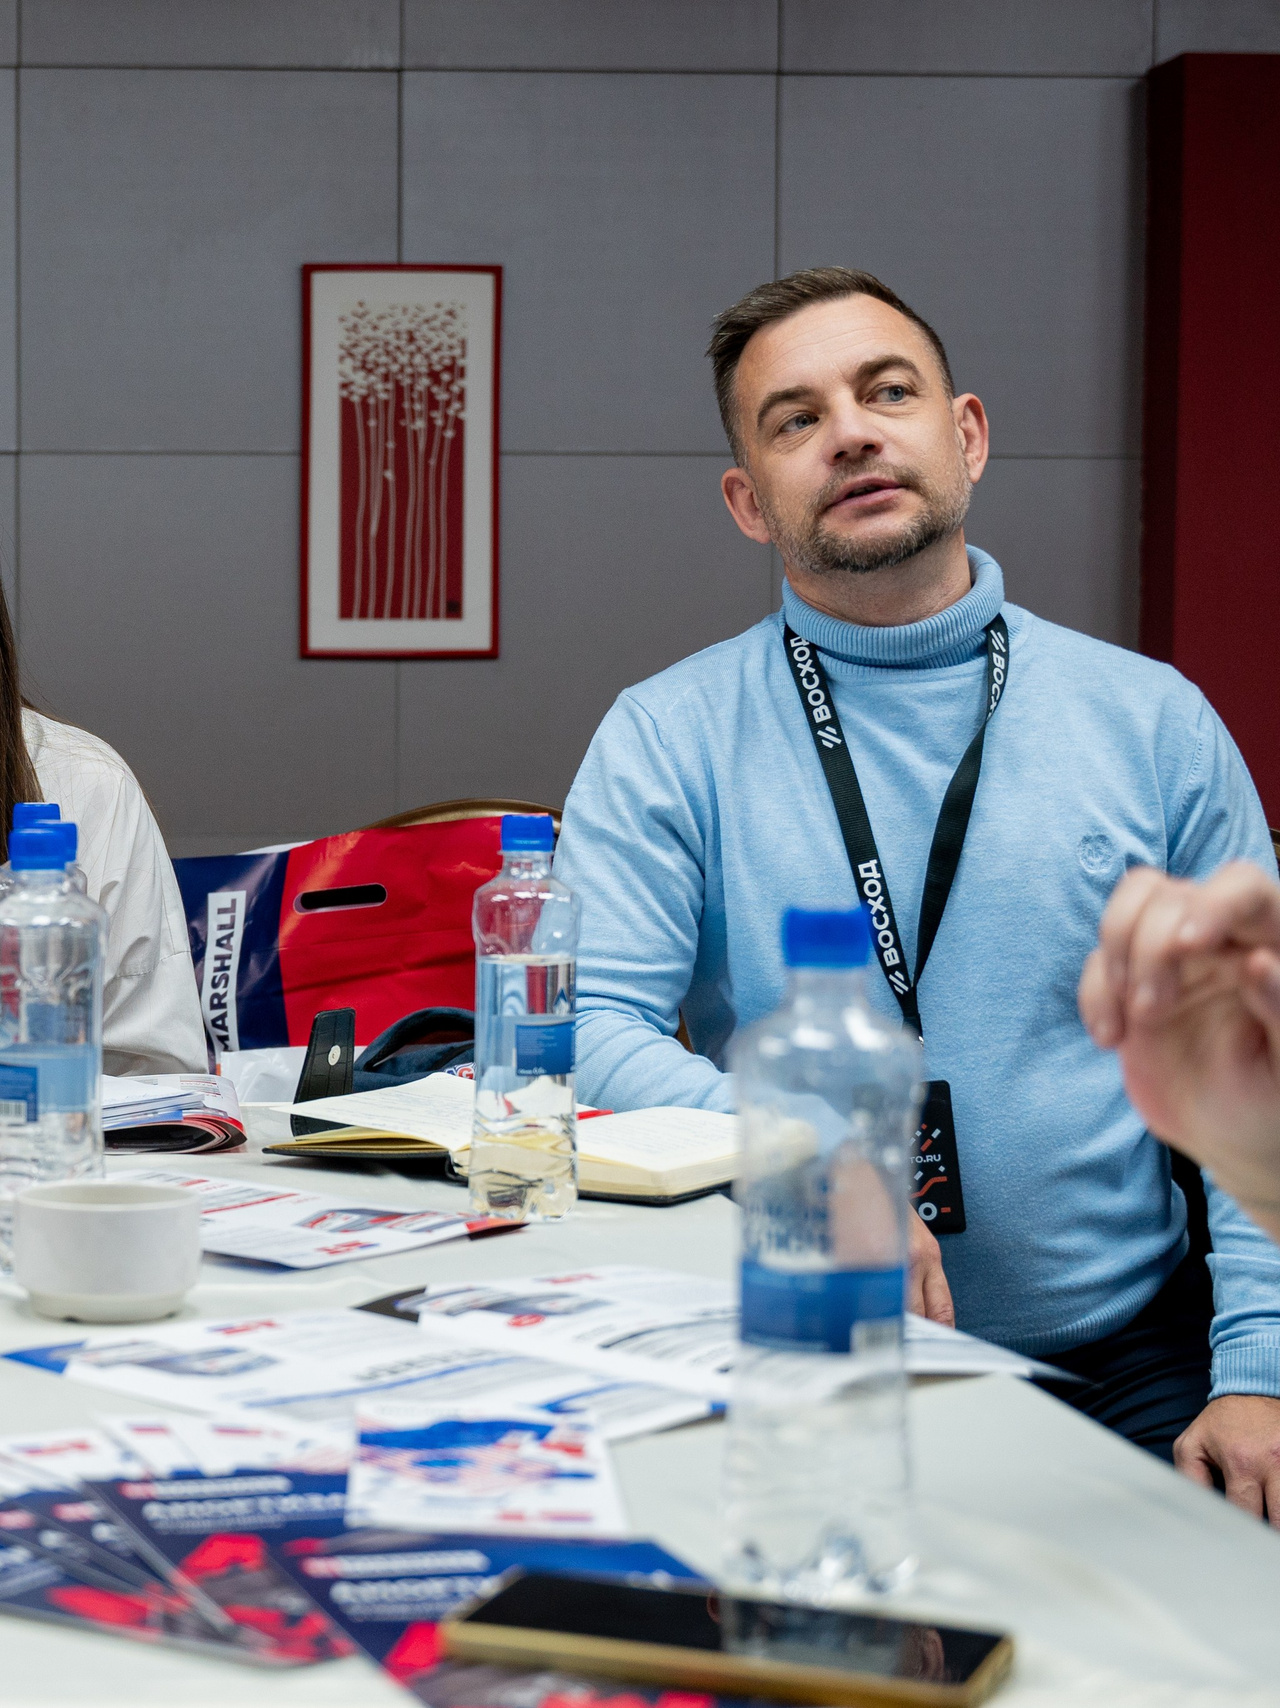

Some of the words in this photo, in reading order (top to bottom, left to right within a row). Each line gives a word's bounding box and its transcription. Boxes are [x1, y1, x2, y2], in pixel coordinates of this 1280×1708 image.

[789, 636, 832, 724] ВОСХОД
[986, 651, 1006, 721] ВОСХ
[857, 858, 901, 967] ВОСХОД
[209, 898, 237, 1052] MARSHALL
[909, 1153, 942, 1164] TO.RU
